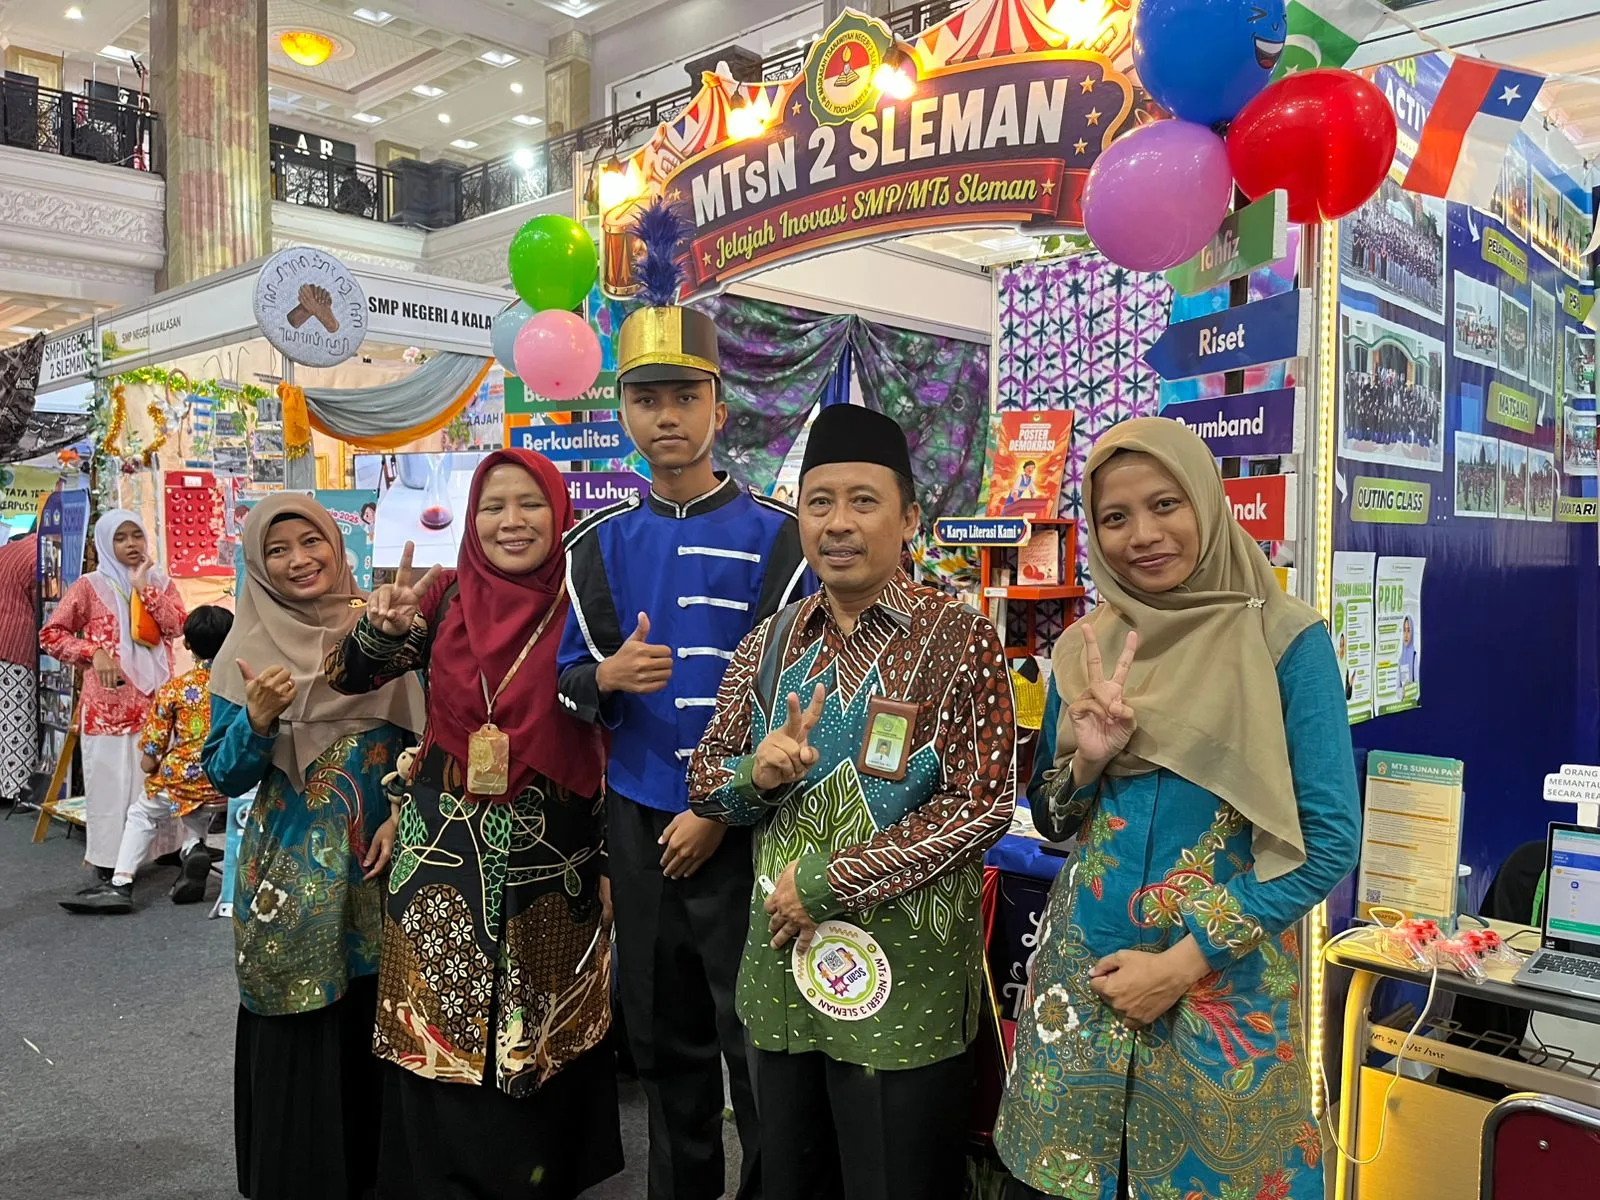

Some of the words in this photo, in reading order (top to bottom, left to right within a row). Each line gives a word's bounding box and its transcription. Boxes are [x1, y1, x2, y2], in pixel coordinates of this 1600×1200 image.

[691, 142, 797, 228] MTsN
[808, 126, 836, 184] 2
[849, 78, 1069, 172] SLEMAN
[715, 220, 775, 269] Jelajah
[779, 196, 848, 238] Inovasi
[851, 174, 949, 221] SMP/MTs
[955, 172, 1037, 204] Sleman
[368, 296, 398, 316] SMP
[402, 301, 448, 324] NEGERI
[450, 310, 459, 326] 4
[462, 311, 493, 331] KALA
[121, 331, 132, 344] SMP
[156, 316, 181, 334] KALASAN
[1199, 323, 1246, 357] Riset
[50, 363, 55, 379] 2
[56, 354, 88, 378] SLEMAN
[524, 384, 615, 403] Bewa
[522, 429, 620, 451] Berkualitas
[1019, 429, 1049, 441] POSTER
[1009, 439, 1056, 452] DEMOKRASI
[6, 488, 28, 498] TATA
[567, 481, 581, 499] di
[585, 481, 639, 499] Luhur
[0, 501, 38, 511] ERPUST
[1357, 488, 1394, 510] OUTING
[1396, 491, 1424, 512] CLASS
[946, 525, 967, 541] Karya
[968, 525, 996, 539] Literasi
[997, 525, 1017, 539] Kami
[1378, 585, 1404, 613] PPDB
[1410, 765, 1439, 775] SUNAN
[1564, 768, 1598, 777] ORANG
[1547, 788, 1582, 798] SECARA
[1584, 791, 1600, 799] REA
[846, 967, 867, 983] Scan
[874, 958, 887, 978] MTs
[868, 979, 888, 1011] NEGERI
[818, 999, 858, 1017] SLEMAN
[861, 1005, 868, 1015] 3
